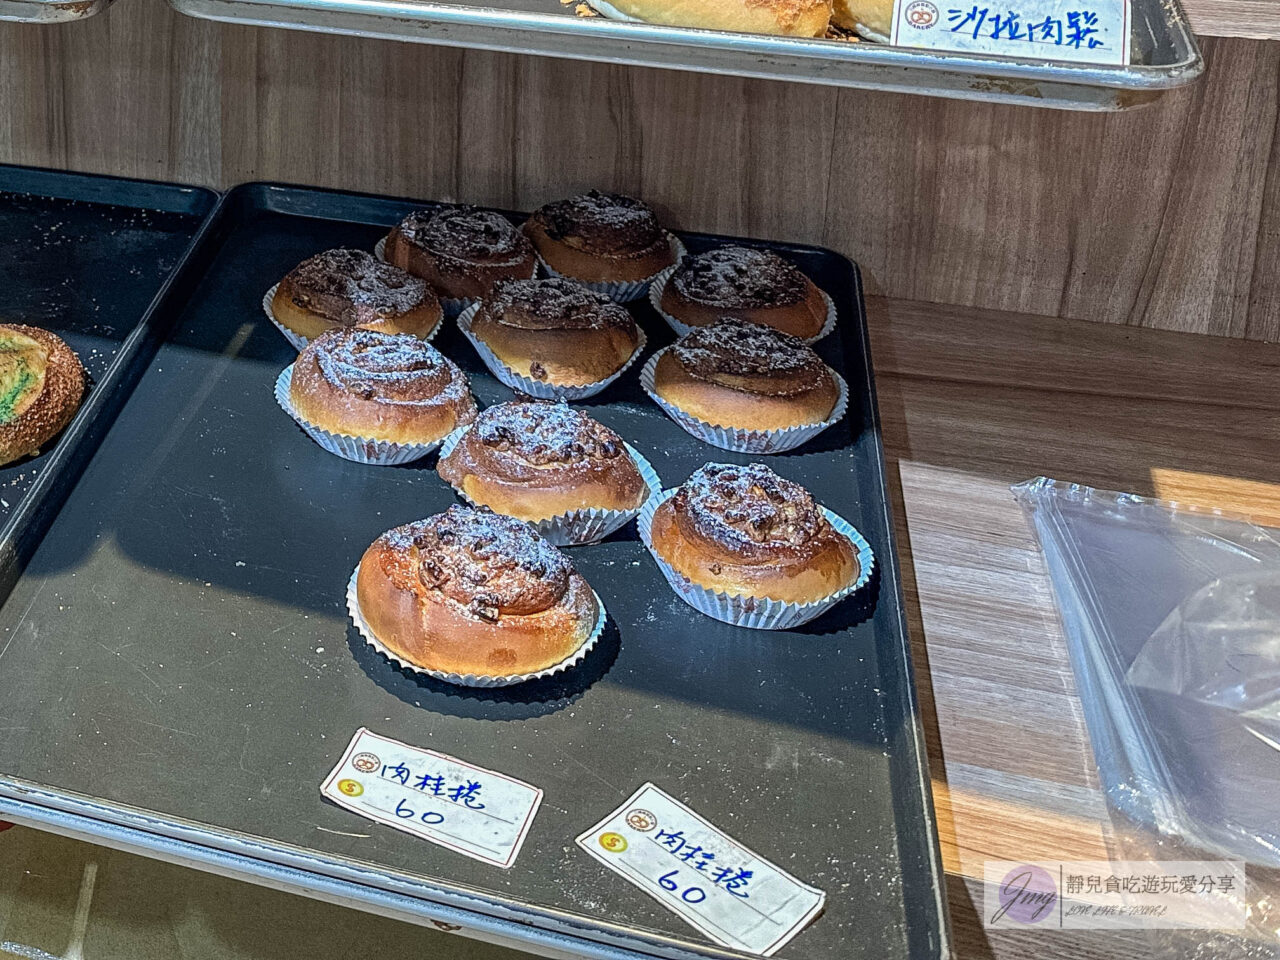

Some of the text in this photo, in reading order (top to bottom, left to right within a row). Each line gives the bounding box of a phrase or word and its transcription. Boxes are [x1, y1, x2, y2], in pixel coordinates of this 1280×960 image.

[381, 762, 486, 810] 肉桂捲
[395, 798, 445, 824] 60
[654, 828, 754, 899] 肉桂捲
[658, 870, 706, 904] 60
